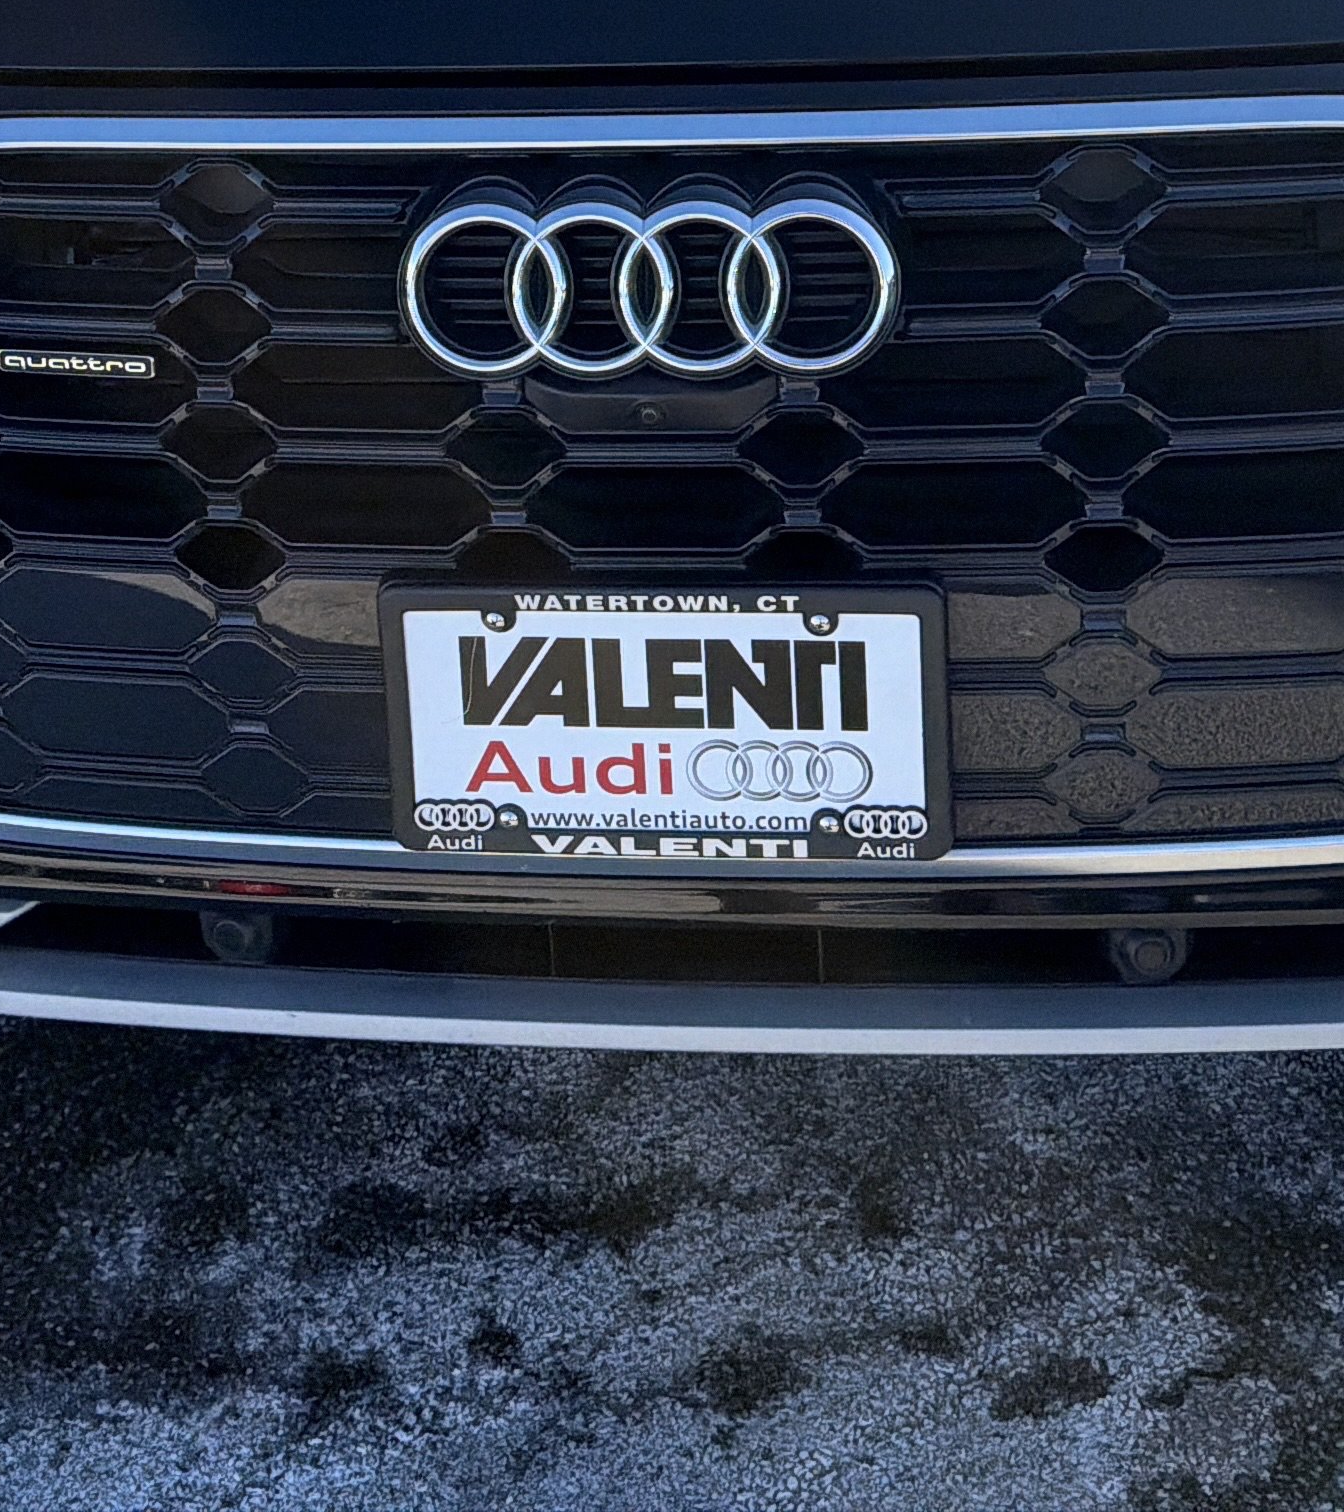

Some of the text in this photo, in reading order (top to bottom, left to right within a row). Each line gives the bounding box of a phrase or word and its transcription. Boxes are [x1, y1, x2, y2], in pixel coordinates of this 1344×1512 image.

[4, 355, 147, 374] quattro
[514, 594, 801, 613] WATERTOWN, CT
[457, 635, 869, 732] VALENTI
[464, 740, 675, 795] Audi
[529, 808, 810, 832] www.valentiauto.com
[426, 834, 484, 852] Audi
[530, 834, 810, 859] VALENTI
[857, 841, 916, 860] Audi
